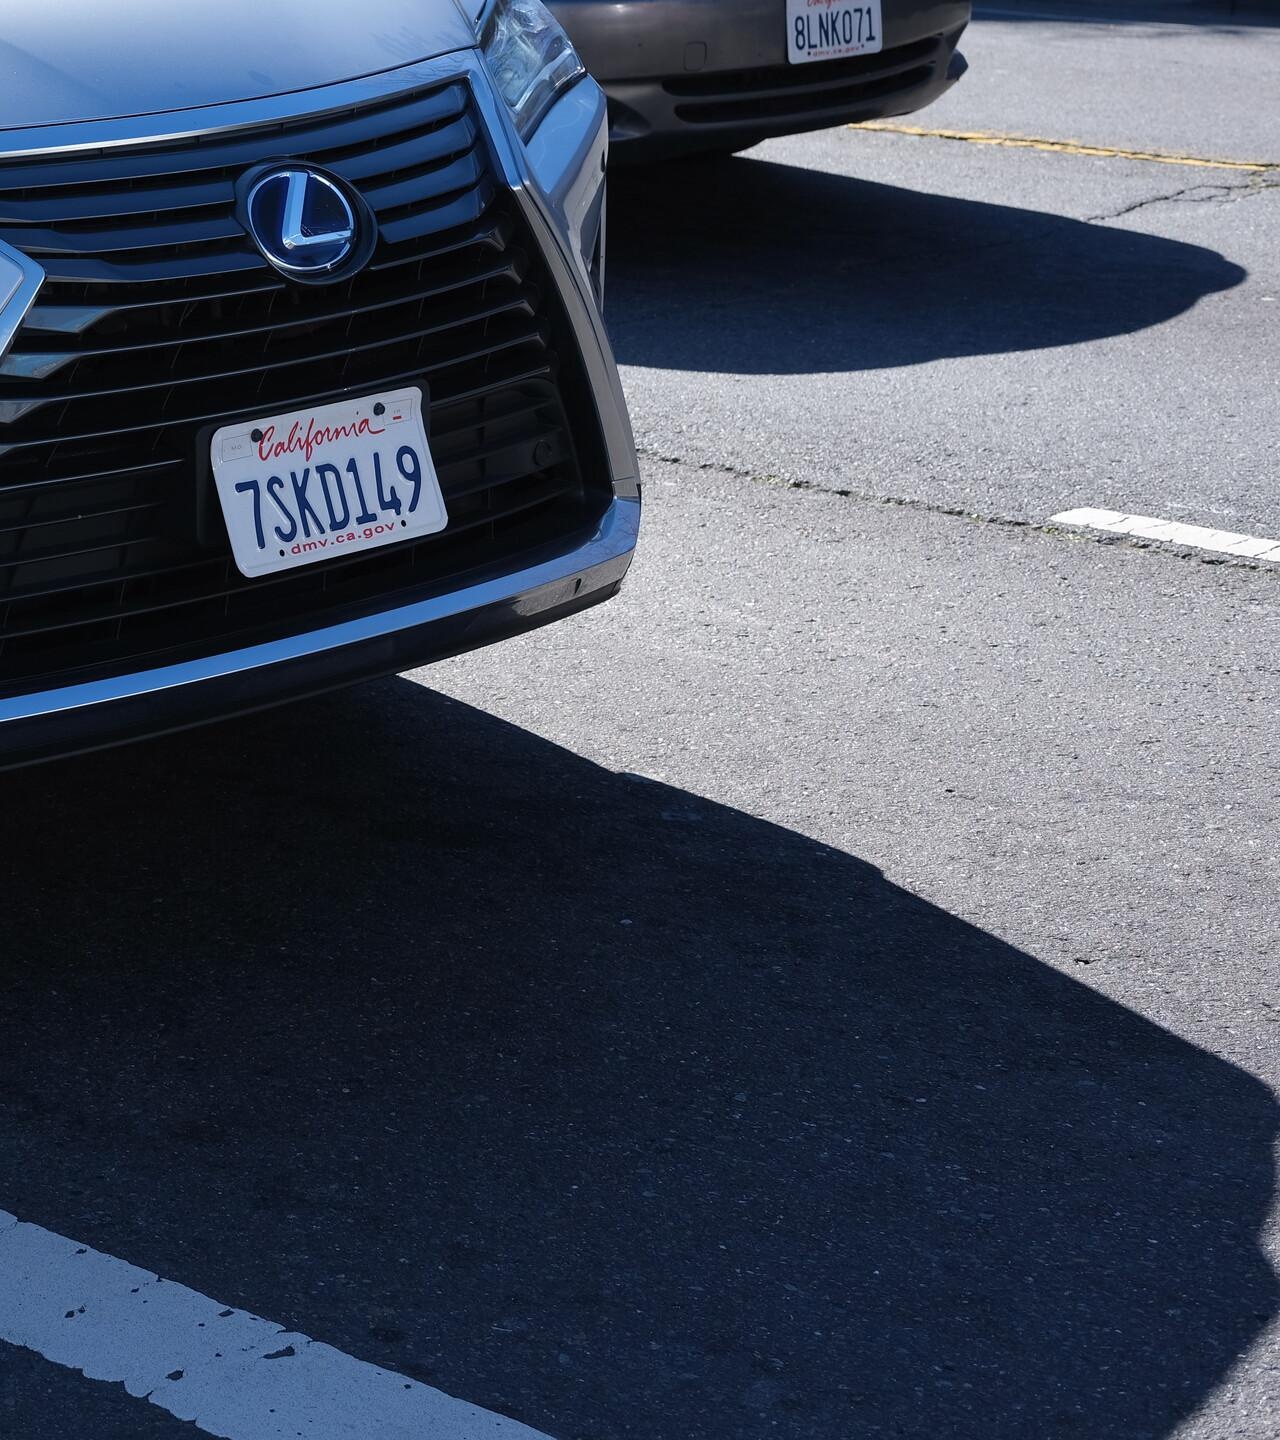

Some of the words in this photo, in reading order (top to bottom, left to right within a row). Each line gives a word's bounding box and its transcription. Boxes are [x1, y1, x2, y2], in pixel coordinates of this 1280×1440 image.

[794, 6, 876, 51] 8LNK071
[258, 417, 386, 462] California
[234, 445, 422, 550] 7SKD149
[290, 522, 396, 556] dmv.ca.gov
